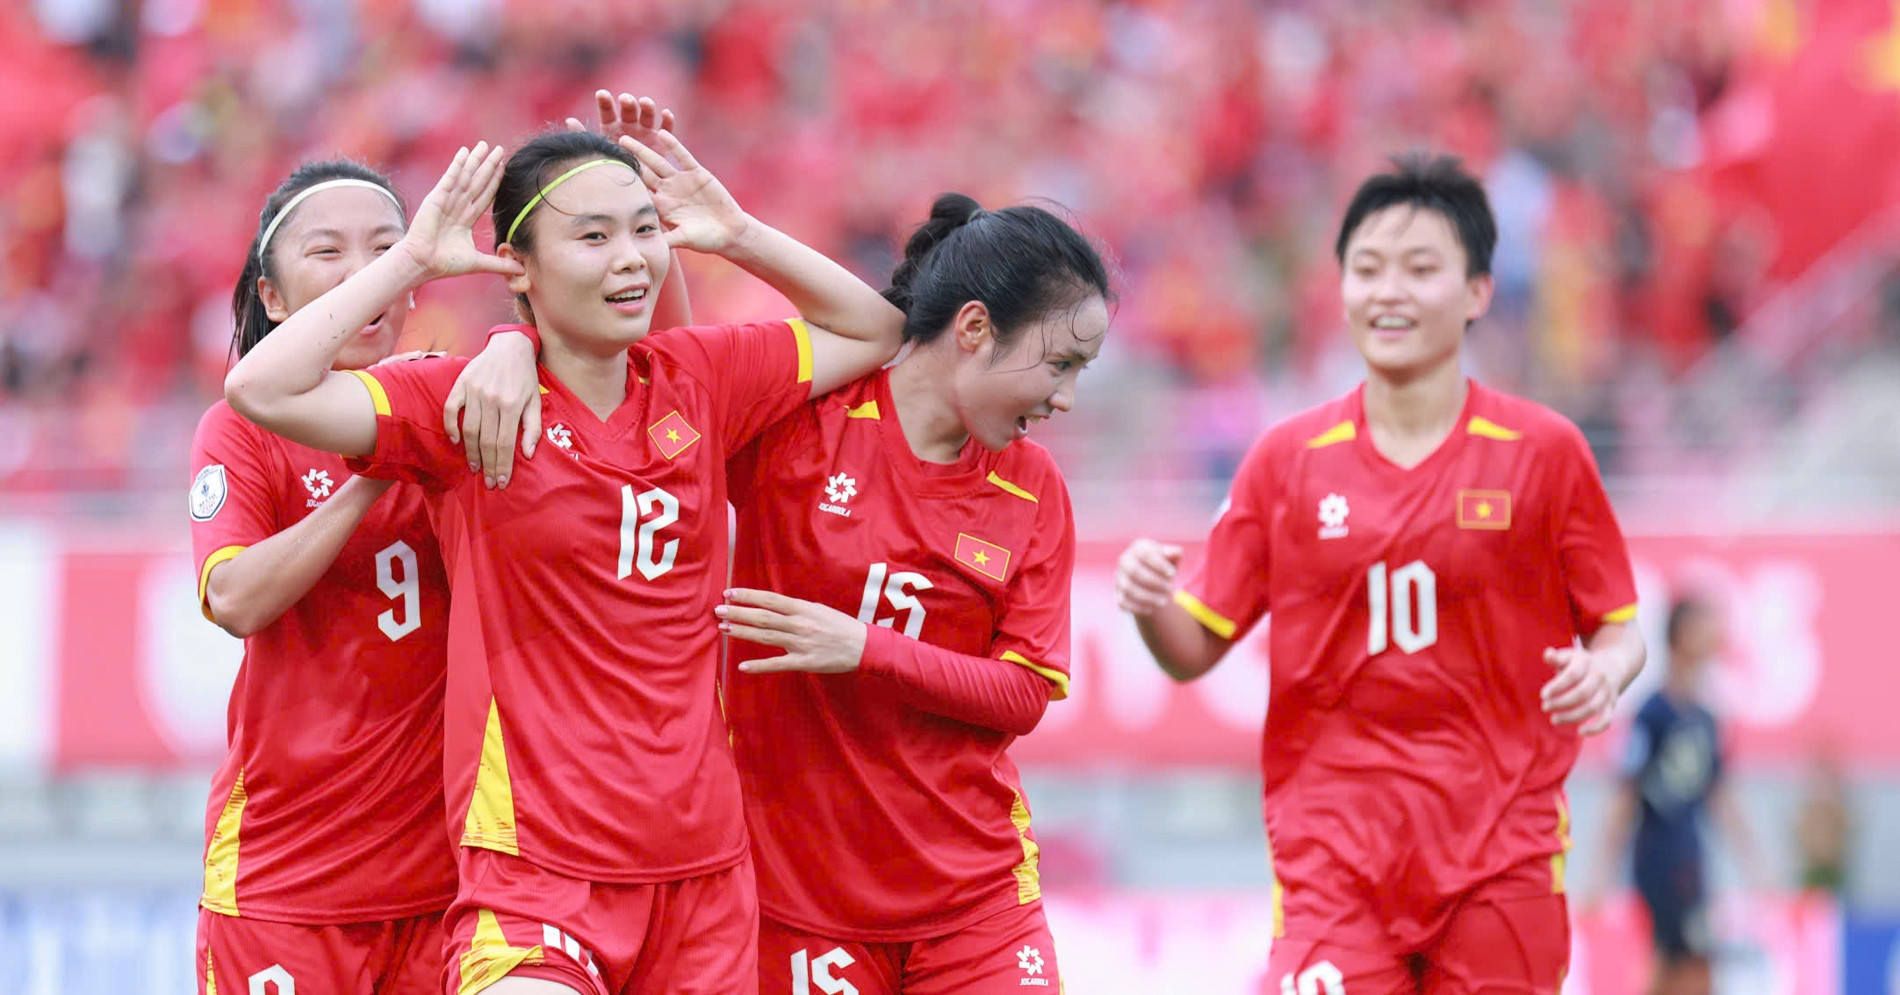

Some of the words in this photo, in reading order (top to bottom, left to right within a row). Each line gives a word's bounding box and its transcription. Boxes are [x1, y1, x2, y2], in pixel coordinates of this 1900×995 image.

[617, 484, 680, 581] 12
[375, 539, 422, 642] 9
[856, 563, 934, 641] 15
[1367, 560, 1438, 655] 10
